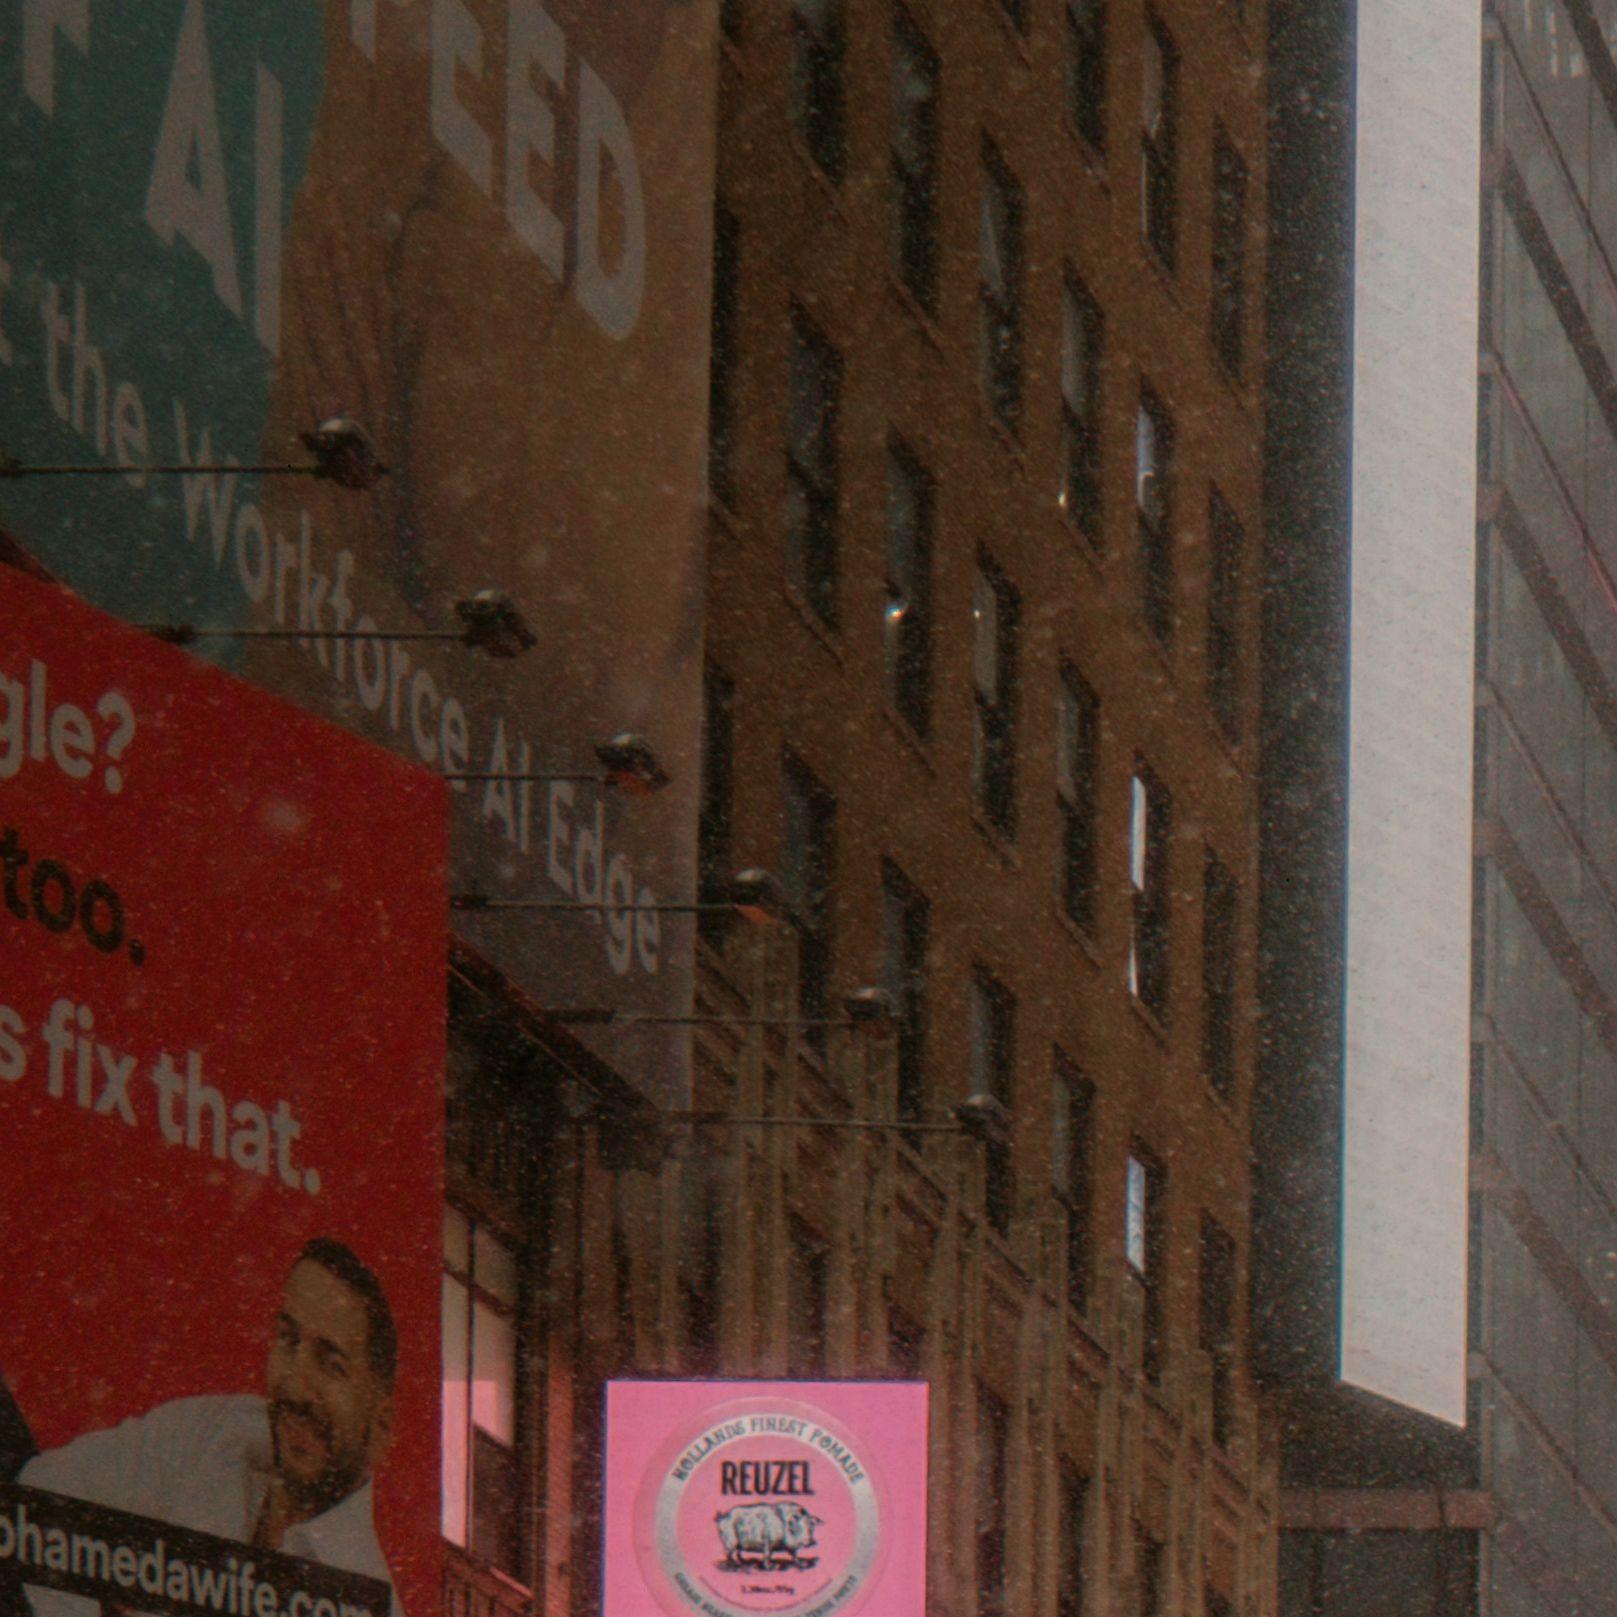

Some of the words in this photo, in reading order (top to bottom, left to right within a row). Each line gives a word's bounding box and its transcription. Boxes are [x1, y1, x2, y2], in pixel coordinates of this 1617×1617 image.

[40, 278, 148, 489] the
[172, 395, 469, 792] Workforce
[42, 1000, 137, 1127] fix
[151, 1050, 321, 1195] that.
[721, 1461, 816, 1495] REUZEL
